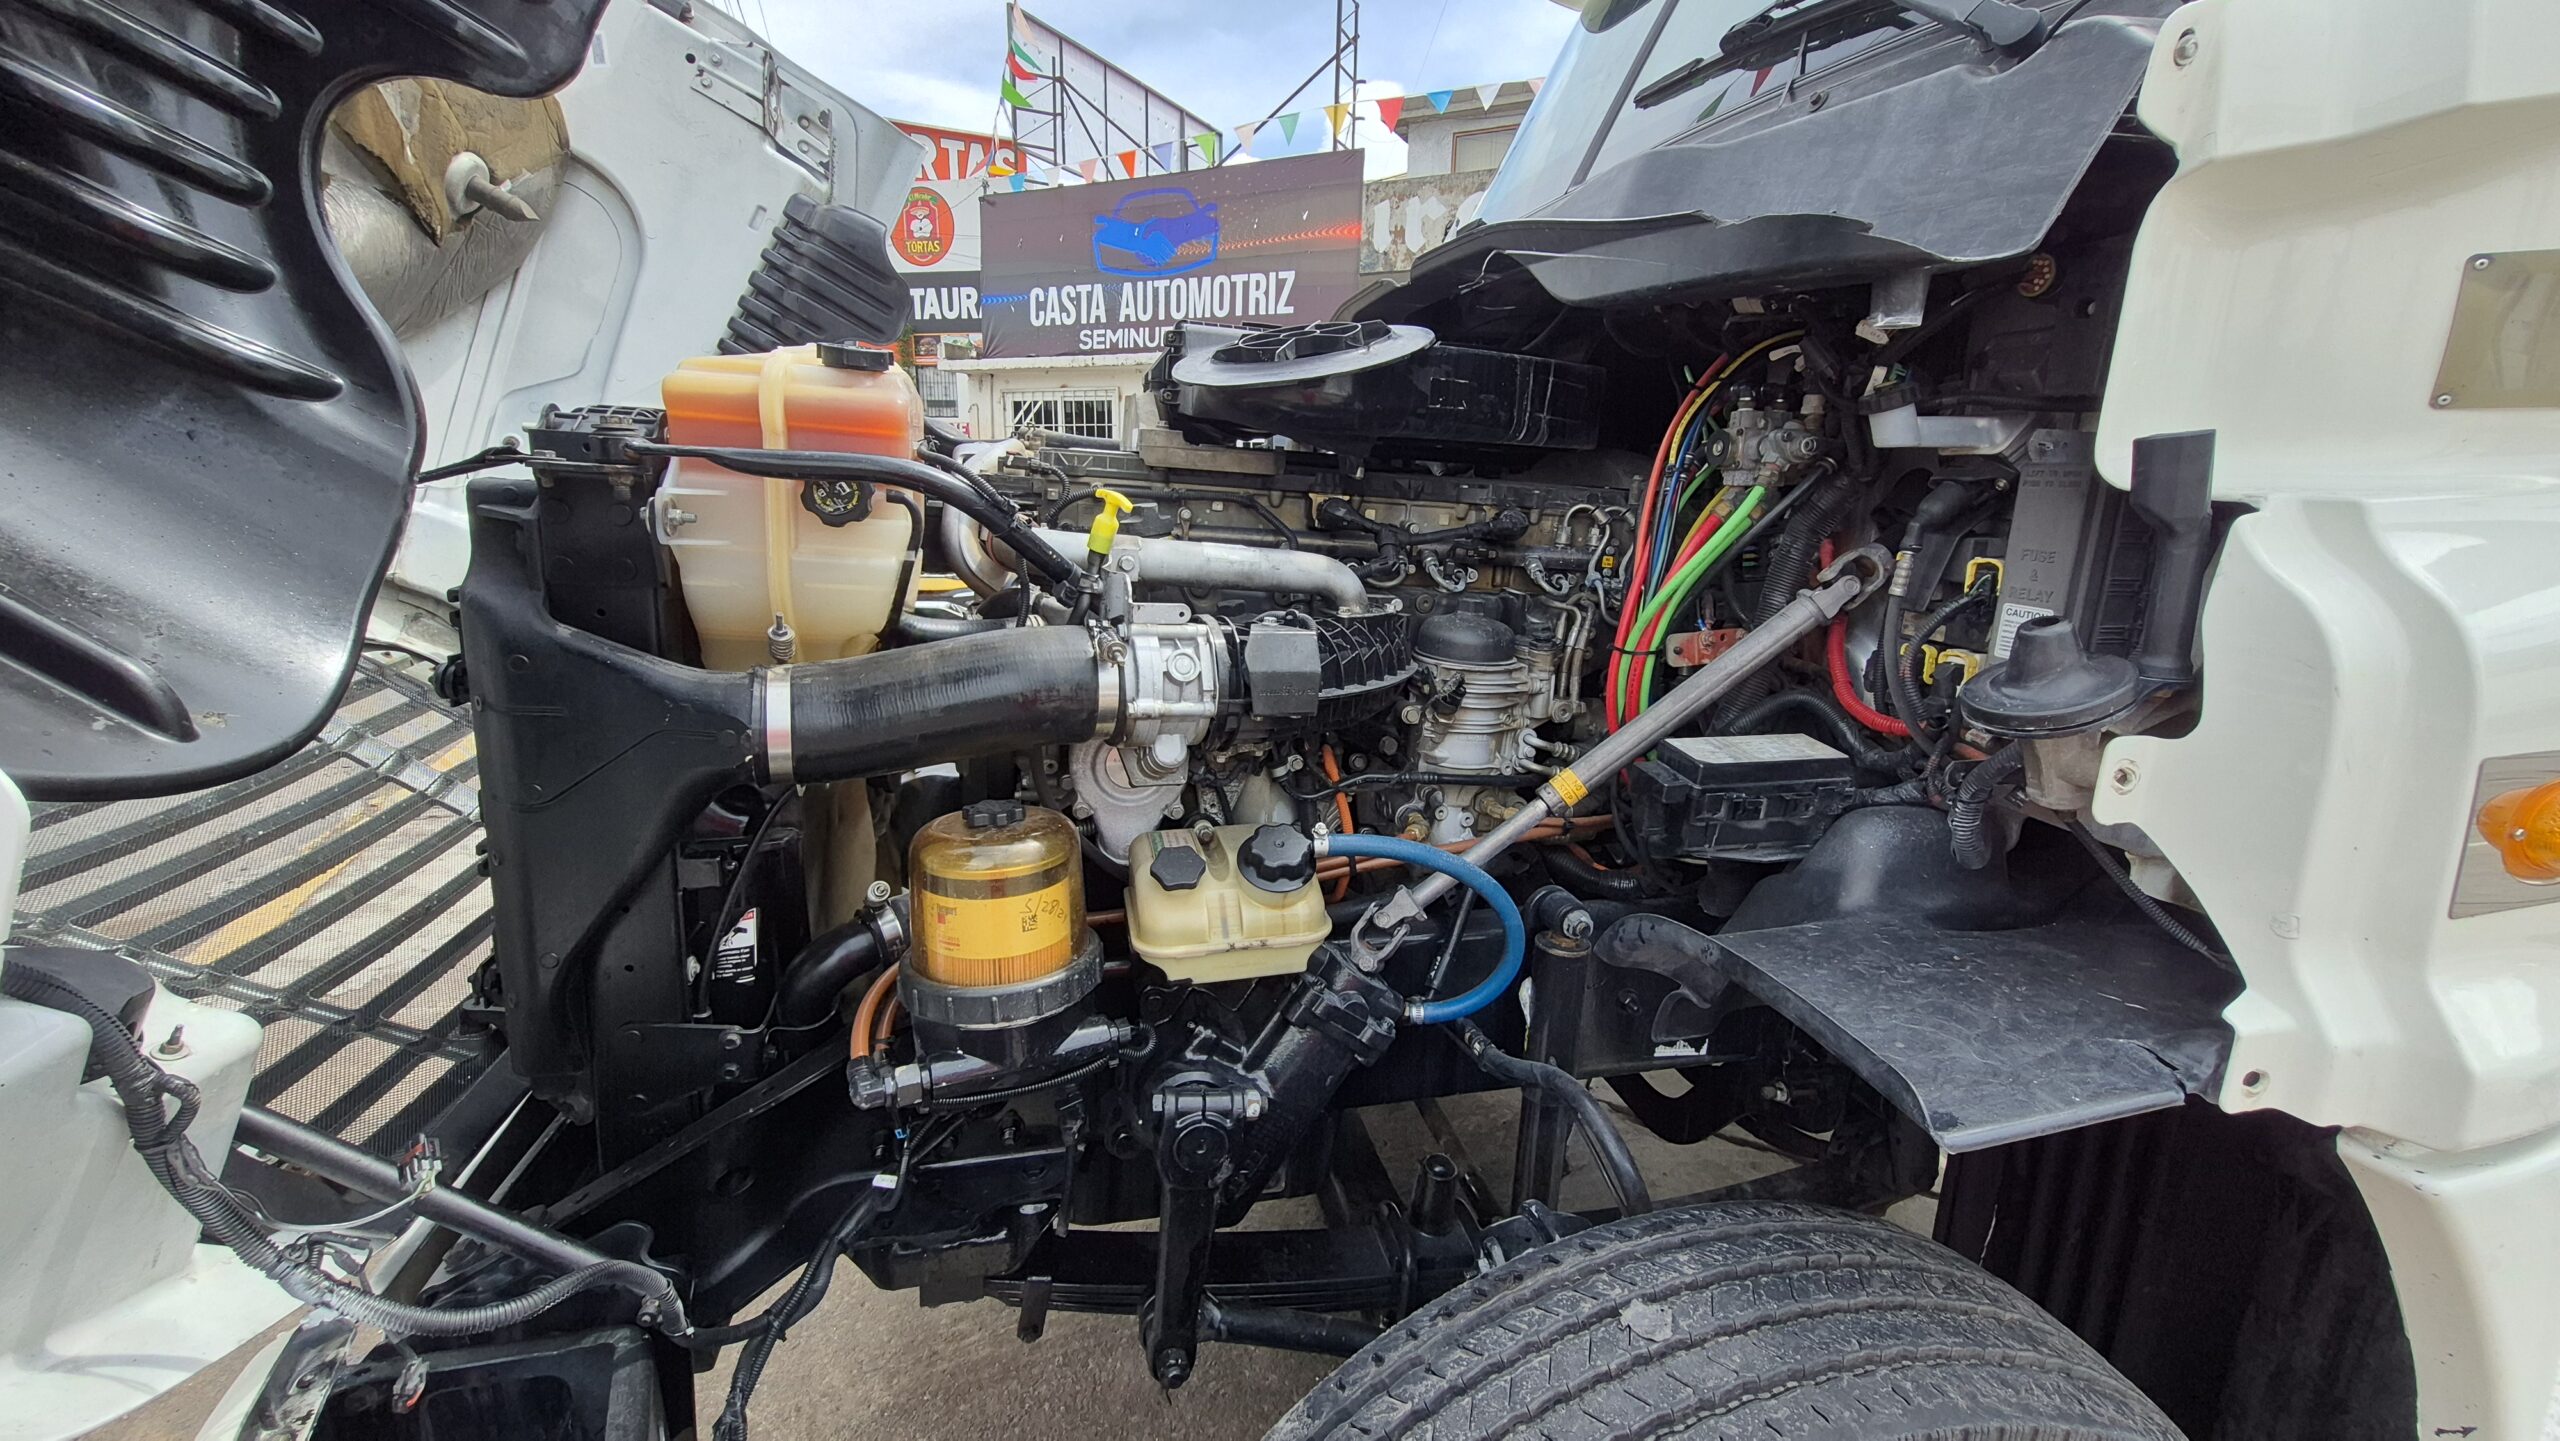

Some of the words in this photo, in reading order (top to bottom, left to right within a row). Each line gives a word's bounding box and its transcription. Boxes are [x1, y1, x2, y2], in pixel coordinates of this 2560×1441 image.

[905, 240, 940, 253] TORTAS
[909, 287, 982, 319] TAUR
[1029, 283, 1107, 326] CASTA
[1118, 270, 1296, 322] AUTOMOTRIZ
[2021, 548, 2056, 564] FUSE
[2008, 586, 2054, 603] RELAY
